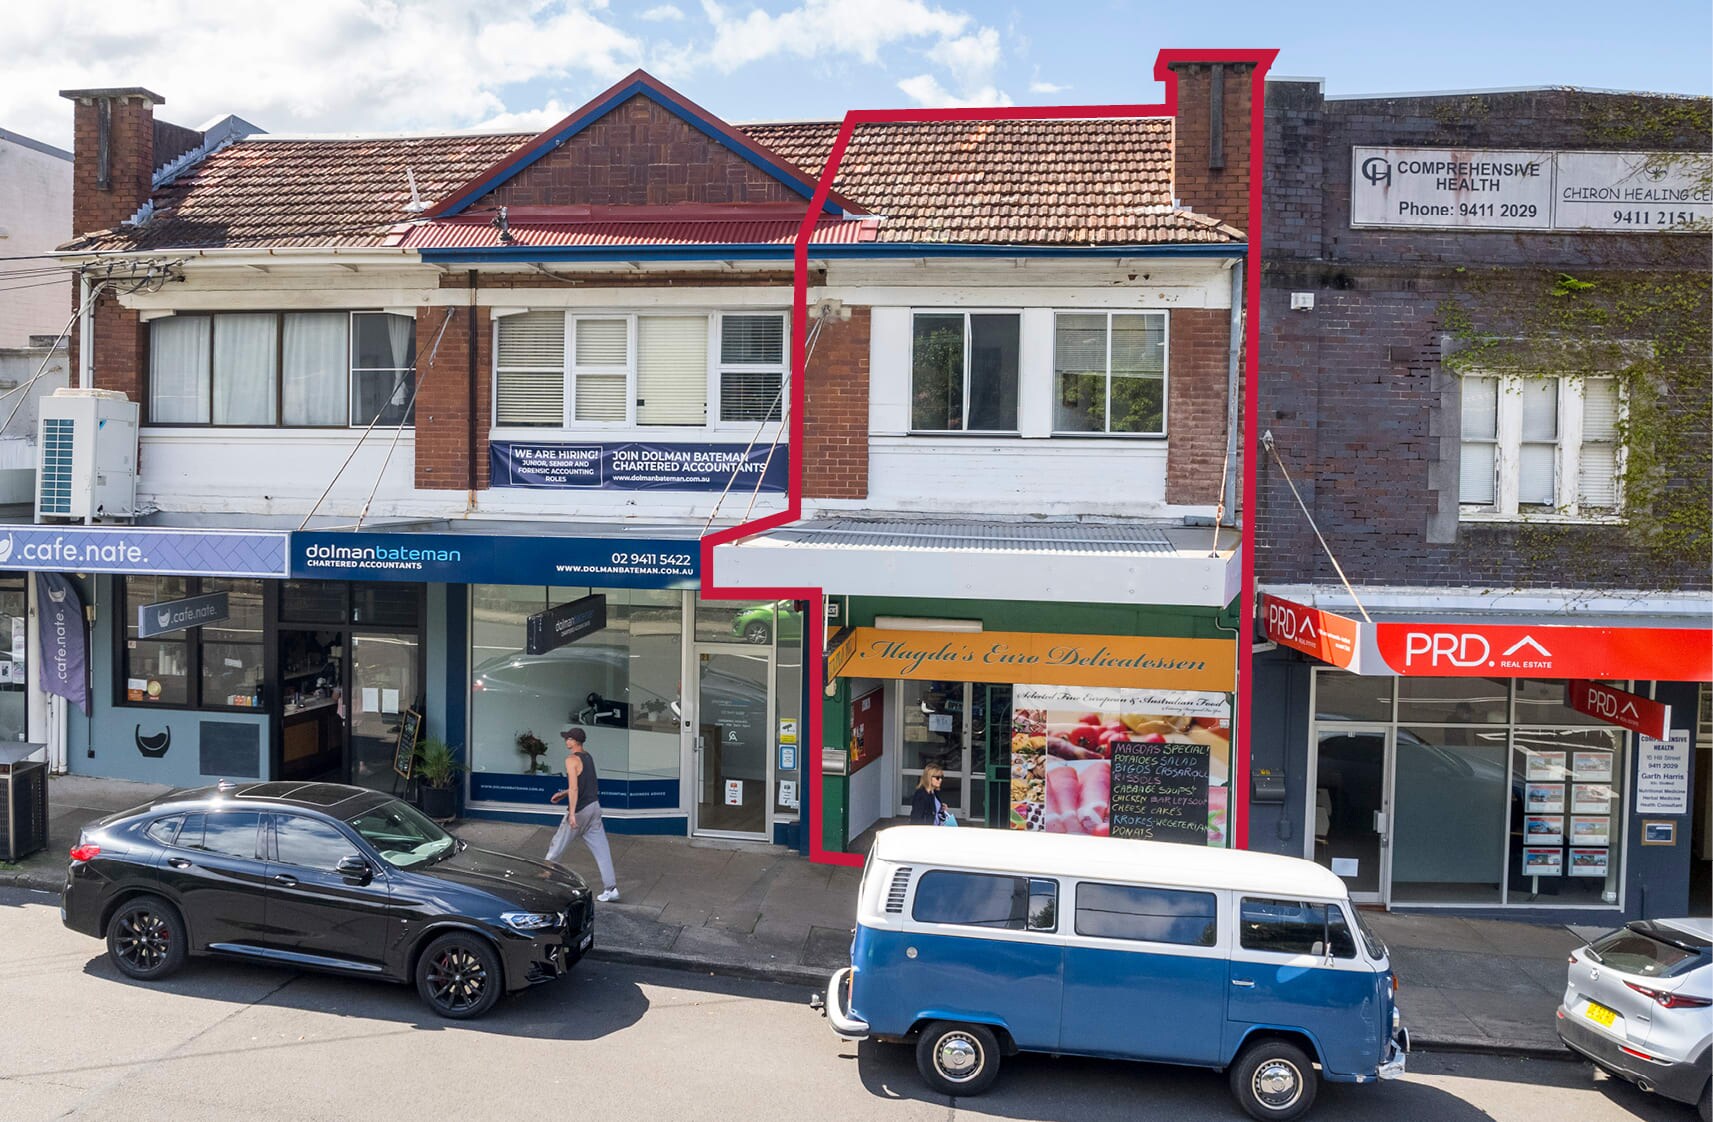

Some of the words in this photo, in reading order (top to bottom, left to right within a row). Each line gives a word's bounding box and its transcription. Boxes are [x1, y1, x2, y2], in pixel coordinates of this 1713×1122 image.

[1397, 161, 1540, 177] COMPREHENSIVE
[1436, 178, 1500, 192] HEALTH
[1563, 187, 1620, 200] CHIRON
[1624, 188, 1689, 201] HEALING
[1693, 189, 1712, 201] CE
[1399, 201, 1454, 216] Phone:
[1459, 203, 1494, 217] 9411
[1500, 204, 1537, 217] 2029
[1613, 210, 1649, 224] 9411
[1657, 211, 1694, 225] 2151
[514, 449, 533, 458] WE
[535, 449, 556, 459] ARE
[559, 450, 598, 459] HIRING!
[612, 451, 639, 461] JOIN
[641, 451, 691, 462] DOLMAN
[693, 452, 749, 463] BATEMAN
[613, 462, 680, 471] CHARTERED
[682, 462, 766, 473] ACCOUNTANTS
[613, 474, 710, 483] www.dolmanbateman.com.au
[17, 537, 149, 563] .cafe.nate.
[306, 544, 461, 562] dolmanbateman
[307, 559, 357, 568] CHARTERED
[359, 560, 422, 570] ACCOUNTANTS
[611, 552, 628, 564] 02
[630, 553, 657, 565] 9411
[659, 554, 691, 566] 5422
[556, 565, 694, 575] WWW.DOLMANBATEMAN.COM.AU
[1269, 604, 1298, 642] PRD.
[1405, 632, 1495, 668] PRD.
[859, 640, 974, 675] Magda's
[983, 644, 1039, 665] Euro
[1045, 646, 1207, 671] Delicatessen
[1523, 661, 1553, 669] ESTATE
[1057, 692, 1081, 701] Fine
[1129, 695, 1139, 706] &
[1139, 695, 1195, 706] Australian
[1195, 697, 1227, 707] Food
[1587, 688, 1619, 719] PRD.
[1160, 757, 1197, 766] SALAD
[1114, 773, 1161, 785] RISSOLS
[1641, 772, 1661, 780] Garth
[1111, 803, 1146, 814] CHEESE
